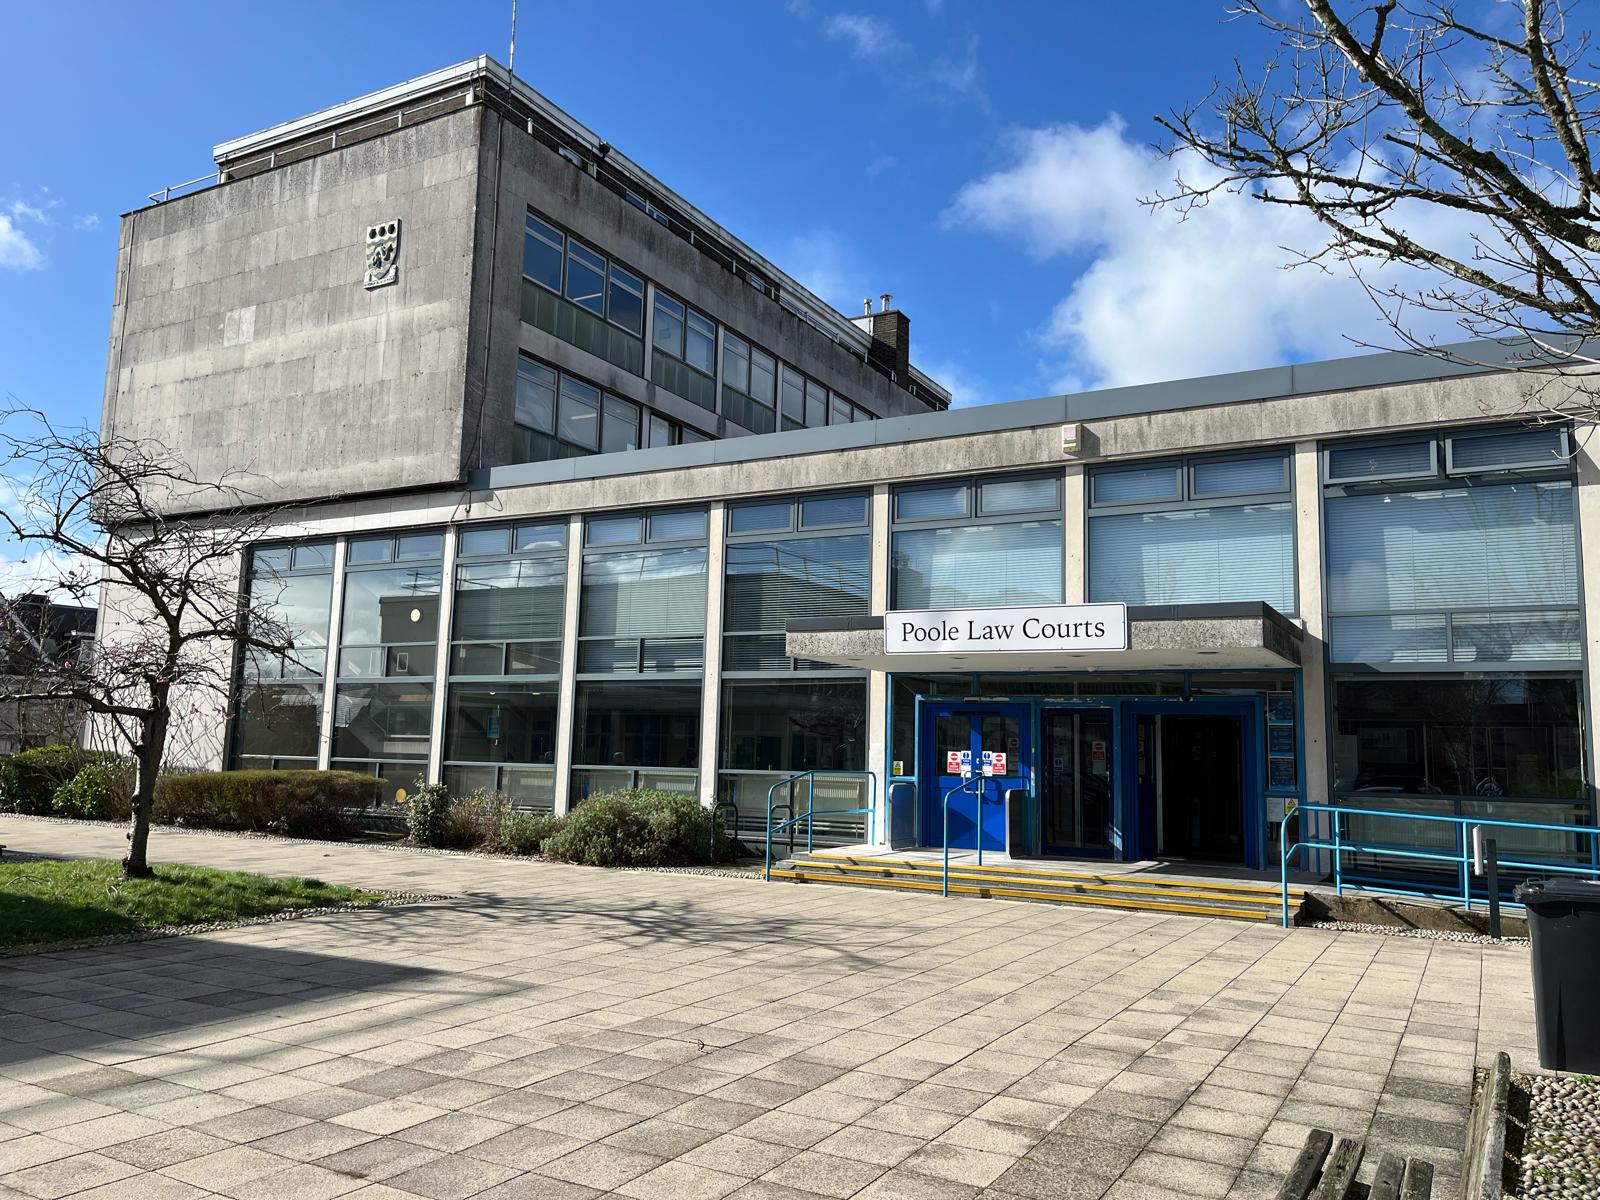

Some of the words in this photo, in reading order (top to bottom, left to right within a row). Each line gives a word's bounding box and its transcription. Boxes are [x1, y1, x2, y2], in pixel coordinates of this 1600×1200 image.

[902, 620, 959, 642] Poole
[967, 620, 1015, 640] Law
[1022, 618, 1105, 639] Courts
